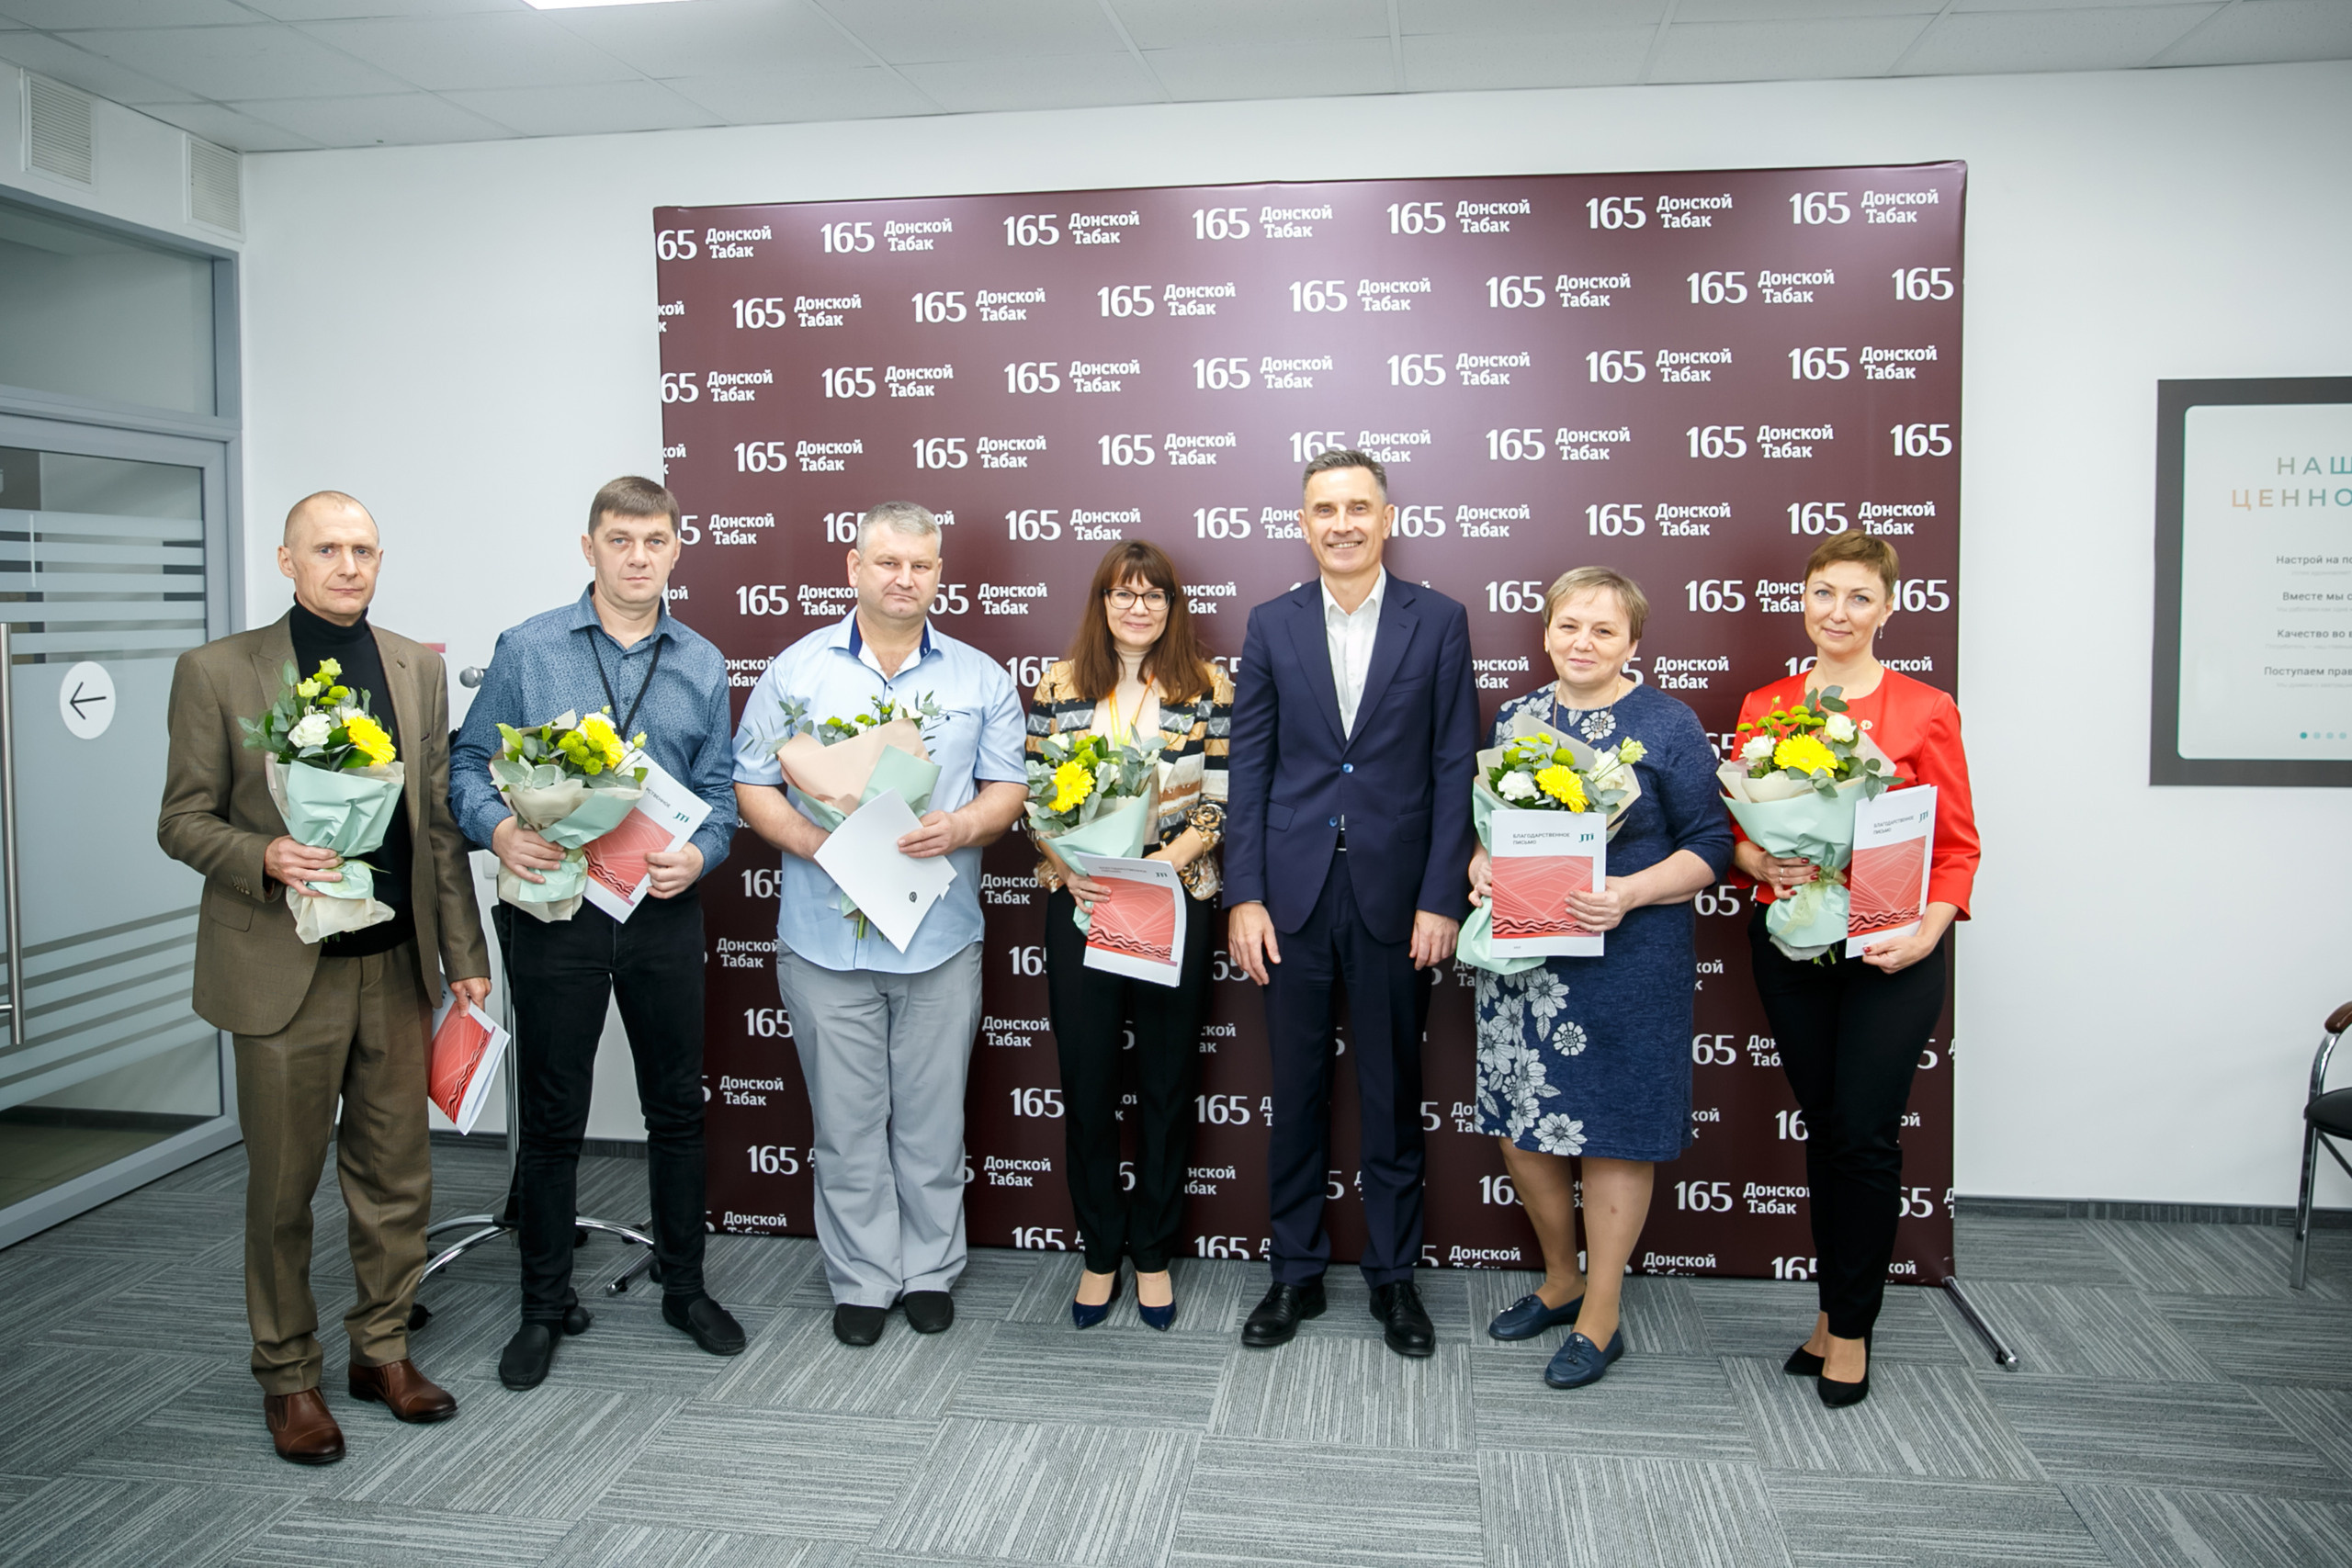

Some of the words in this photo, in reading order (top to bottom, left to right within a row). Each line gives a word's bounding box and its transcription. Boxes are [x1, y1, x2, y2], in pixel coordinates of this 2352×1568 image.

[1657, 194, 1732, 212] Донской
[1861, 189, 1939, 208] Донской
[1260, 205, 1332, 223] Донской
[1456, 199, 1530, 218] Донской
[1587, 197, 1645, 229] 165
[1790, 192, 1850, 224] 165
[1866, 207, 1917, 223] Табак
[1069, 211, 1139, 230] Донской
[1193, 208, 1250, 239] 165
[1387, 202, 1445, 234] 165
[1460, 217, 1510, 232] Табак
[1661, 212, 1711, 228] Табак
[706, 226, 772, 244] Донской
[884, 219, 952, 237] Донской
[1003, 215, 1059, 245] 165
[1073, 229, 1120, 243] Табак
[1264, 222, 1312, 238] Табак
[657, 230, 697, 260] 65
[821, 222, 875, 253] 165
[888, 235, 933, 251] Табак
[709, 243, 753, 258] Табак
[1357, 278, 1430, 296] Донской
[1555, 274, 1631, 292] Донской
[1758, 269, 1834, 288] Донской
[1892, 267, 1953, 300] 165
[1164, 282, 1236, 301] Донской
[1289, 280, 1347, 311] 165
[1487, 276, 1545, 308] 165
[1687, 272, 1747, 304] 165
[1762, 287, 1813, 303] Табак
[794, 294, 862, 312] Донской
[976, 288, 1046, 307] Донской
[1098, 286, 1154, 317] 165
[1362, 296, 1410, 311] Табак
[1560, 291, 1610, 307] Табак
[733, 298, 786, 328] 165
[912, 292, 967, 322] 165
[980, 305, 1026, 321] Табак
[1168, 299, 1216, 315] Табак
[798, 311, 842, 327] Табак
[1456, 352, 1530, 370] Донской
[1657, 348, 1732, 367] Донской
[1789, 347, 1849, 379] 165
[1860, 345, 1937, 364] Донской
[1069, 360, 1140, 378] Донской
[1261, 355, 1333, 373] Донской
[1387, 355, 1445, 386] 165
[1586, 351, 1645, 382] 165
[1864, 363, 1916, 379] Табак
[707, 369, 773, 388] Донской
[822, 367, 876, 398] 165
[885, 365, 953, 382] Донской
[1004, 362, 1060, 393] 165
[1193, 358, 1250, 389] 165
[1264, 373, 1313, 389] Табак
[1460, 369, 1510, 385] Табак
[1660, 366, 1711, 382] Табак
[661, 372, 699, 403] 65
[888, 381, 934, 397] Табак
[1074, 377, 1121, 392] Табак
[711, 387, 754, 401] Табак
[1164, 433, 1236, 450] Донской
[1358, 430, 1430, 447] Донской
[1555, 427, 1630, 445] Донской
[1687, 426, 1747, 457] 165
[1757, 424, 1833, 442] Донской
[1891, 423, 1951, 457] 165
[796, 440, 863, 457] Донской
[913, 438, 967, 468] 165
[977, 435, 1046, 453] Донской
[1099, 434, 1155, 465] 165
[1486, 429, 1544, 460] 165
[1560, 445, 1609, 460] Табак
[1761, 442, 1812, 457] Табак
[734, 442, 786, 472] 165
[799, 456, 844, 471] Табак
[981, 453, 1027, 468] Табак
[1169, 449, 1216, 465] Табак
[1070, 508, 1141, 525] Донской
[1456, 504, 1530, 522] Донской
[1656, 502, 1731, 520] Донской
[1787, 502, 1849, 536] 165
[1859, 502, 1936, 519] Донской
[709, 513, 775, 530] Донской
[823, 512, 867, 543] 16
[1005, 510, 1061, 540] 165
[1193, 507, 1250, 538] 165
[1586, 504, 1645, 536] 165
[1660, 520, 1710, 536] Табак
[1862, 519, 1914, 536] Табак
[713, 529, 756, 545] Табак
[1075, 525, 1121, 540] Табак
[1460, 522, 1510, 537] Табак
[2276, 555, 2323, 566] Настрой
[736, 585, 789, 615] 165
[929, 584, 969, 615] 65
[978, 582, 1047, 600] Донской
[1486, 581, 1545, 613] 165
[1685, 580, 1746, 612] 165
[2282, 592, 2323, 601] Вместе
[802, 600, 846, 615] Табак
[982, 599, 1028, 615] Табак
[1188, 598, 1217, 614] бак
[2277, 629, 2329, 638] Качество
[1654, 656, 1729, 672] Донской
[2264, 666, 2324, 678] Поступаем
[1658, 672, 1709, 689] Табак
[985, 889, 1031, 906] Табак
[1694, 885, 1740, 916] 65
[720, 953, 763, 968] Табак
[1009, 945, 1047, 976] 16
[743, 1009, 793, 1038] 165
[982, 1015, 1050, 1032] Донской
[987, 1032, 1032, 1047] Табак
[1691, 1033, 1736, 1066] 65
[719, 1075, 784, 1091] Донской
[724, 1090, 767, 1106] Табак
[1010, 1088, 1065, 1118] 165
[1194, 1094, 1250, 1125] 165
[1775, 1110, 1808, 1141] 16
[747, 1145, 798, 1175] 165
[983, 1156, 1052, 1172] Донской
[988, 1171, 1033, 1187] Табак
[1674, 1181, 1733, 1213] 165
[1747, 1198, 1797, 1214] Табак
[723, 1211, 787, 1227] Донской
[1012, 1227, 1066, 1250] 165
[1194, 1235, 1250, 1260] 165
[1449, 1245, 1521, 1261] Донской
[1643, 1251, 1716, 1268] Донской
